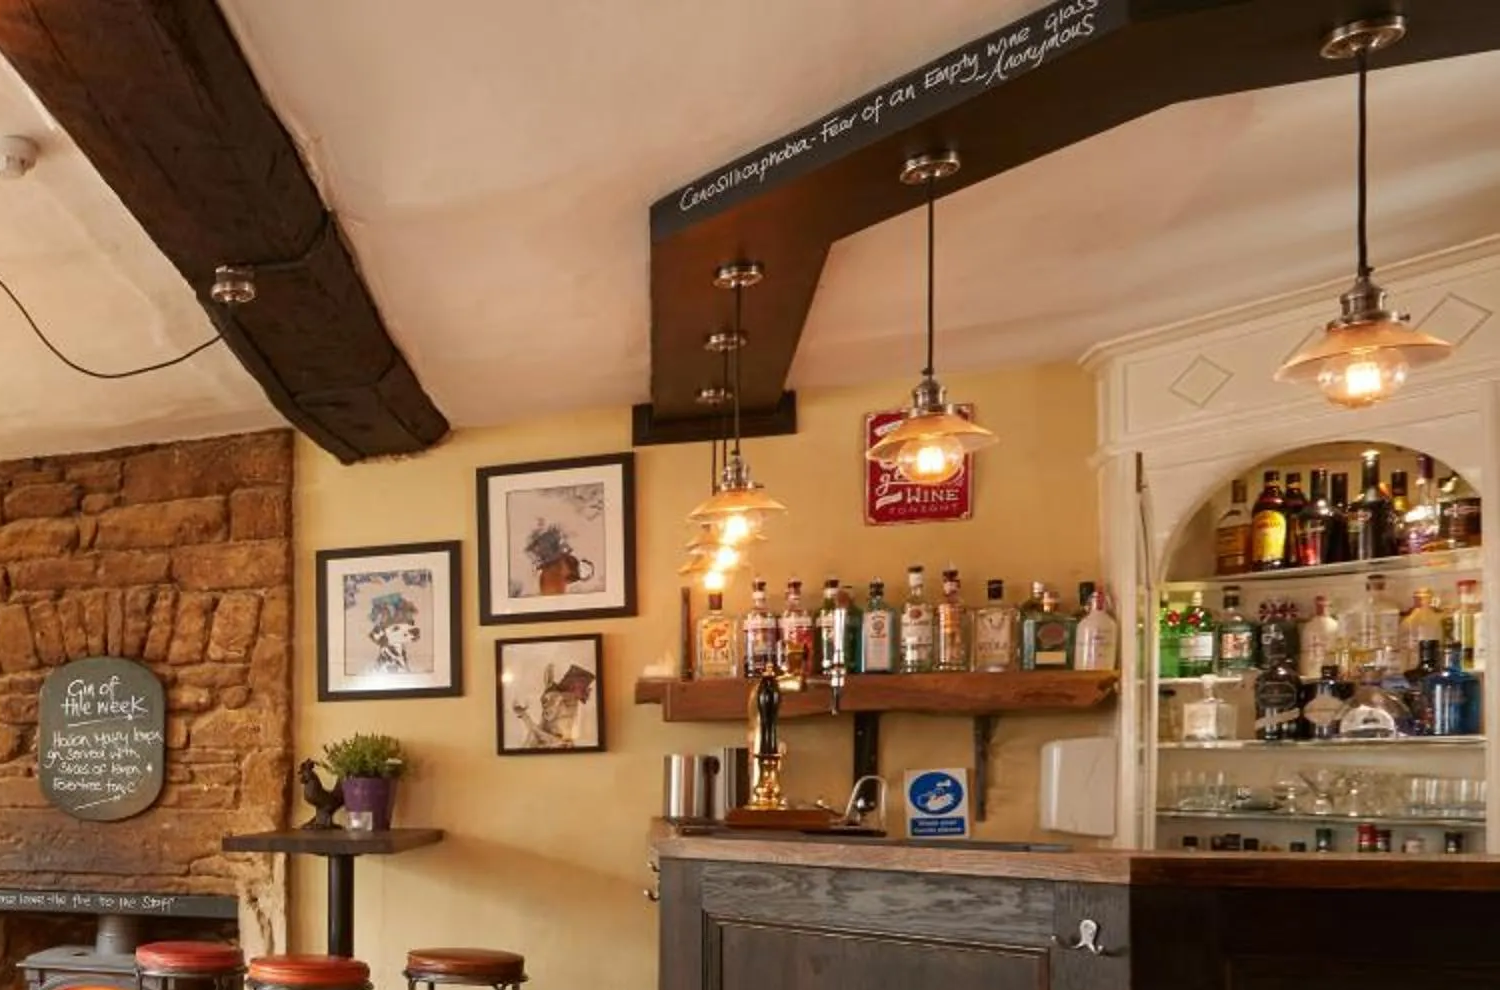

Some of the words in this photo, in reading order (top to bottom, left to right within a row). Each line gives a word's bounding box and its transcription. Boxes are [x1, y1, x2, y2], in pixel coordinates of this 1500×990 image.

[819, 113, 857, 144] Fear
[861, 96, 883, 124] of
[889, 84, 916, 107] an
[924, 53, 980, 90] Empty
[987, 27, 1031, 57] wine
[1043, 0, 1099, 33] glass
[906, 486, 960, 504] WINE
[67, 679, 96, 698] Gin
[99, 675, 121, 701] of
[60, 696, 93, 717] the
